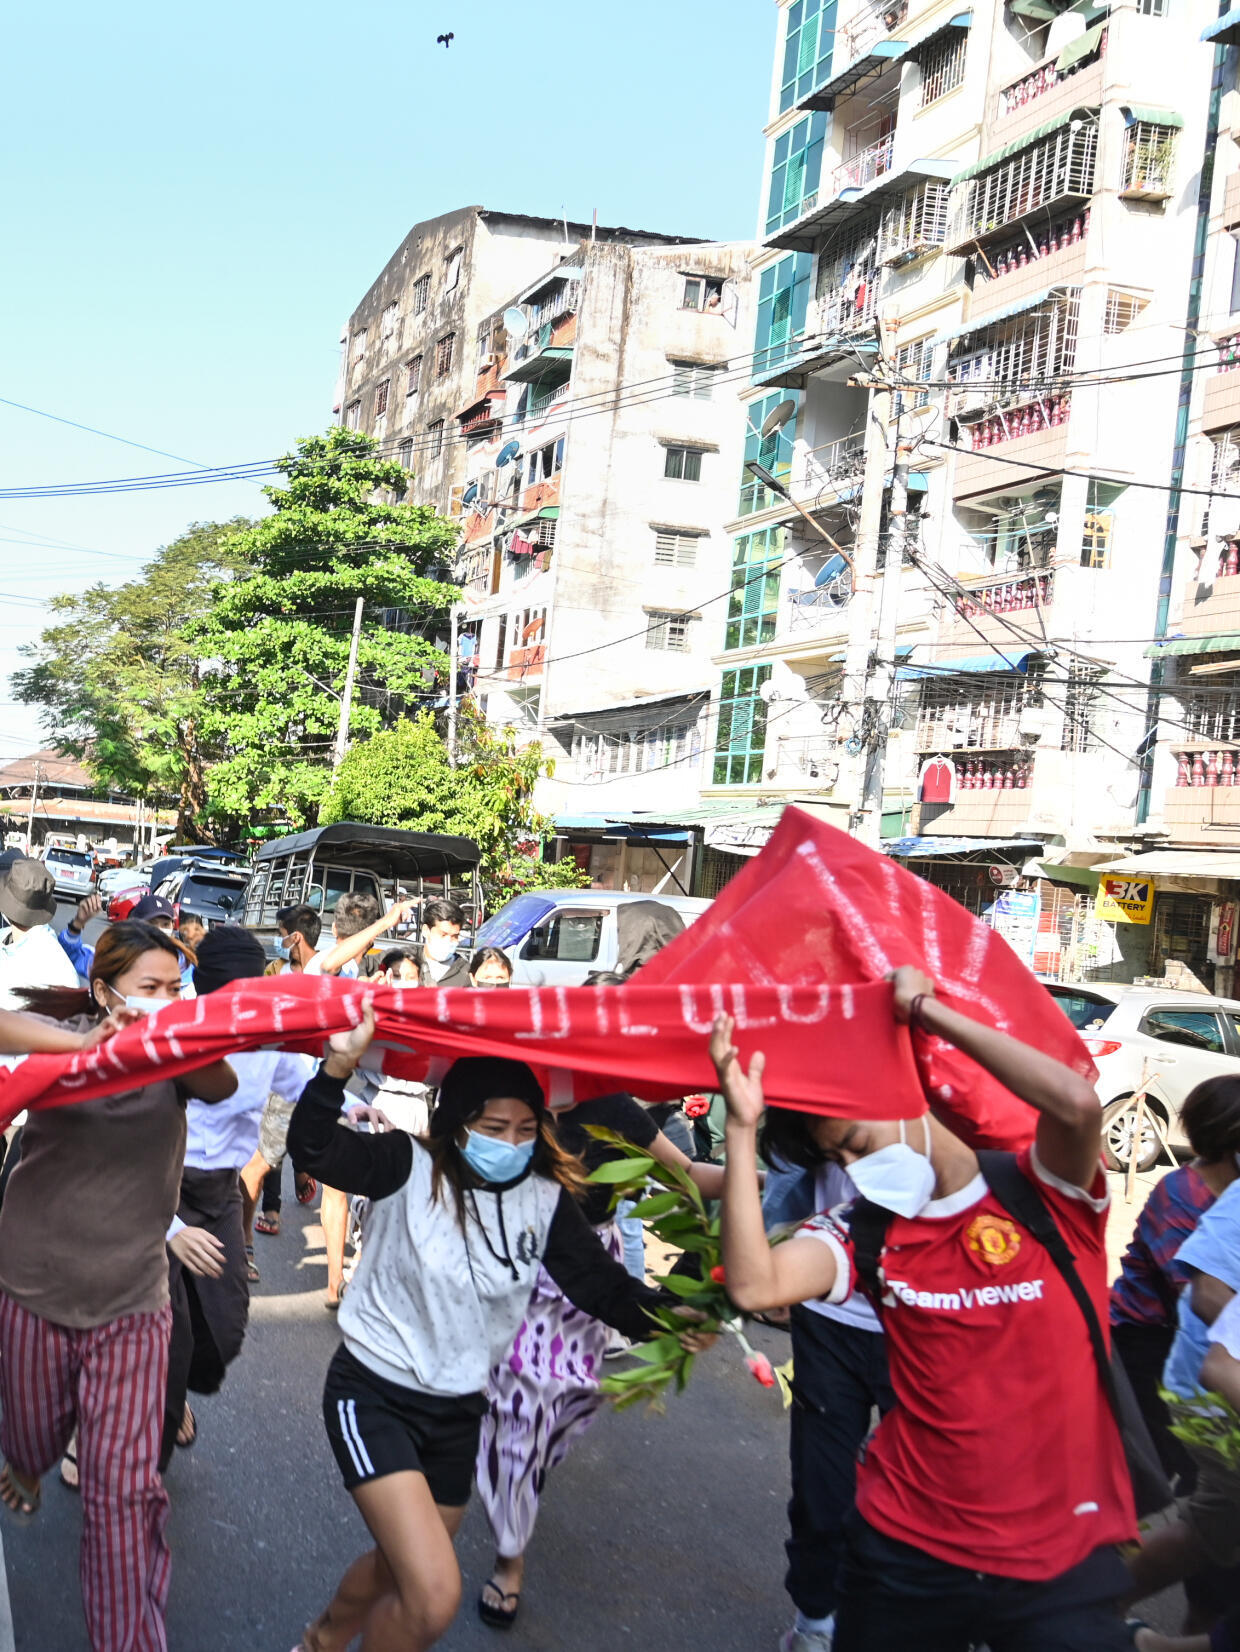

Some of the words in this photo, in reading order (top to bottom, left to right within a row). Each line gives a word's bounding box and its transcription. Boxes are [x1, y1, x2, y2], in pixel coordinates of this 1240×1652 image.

[1108, 881, 1145, 902] 3K
[1103, 900, 1146, 911] BATTERY
[886, 1279, 1044, 1310] TeamViewer
